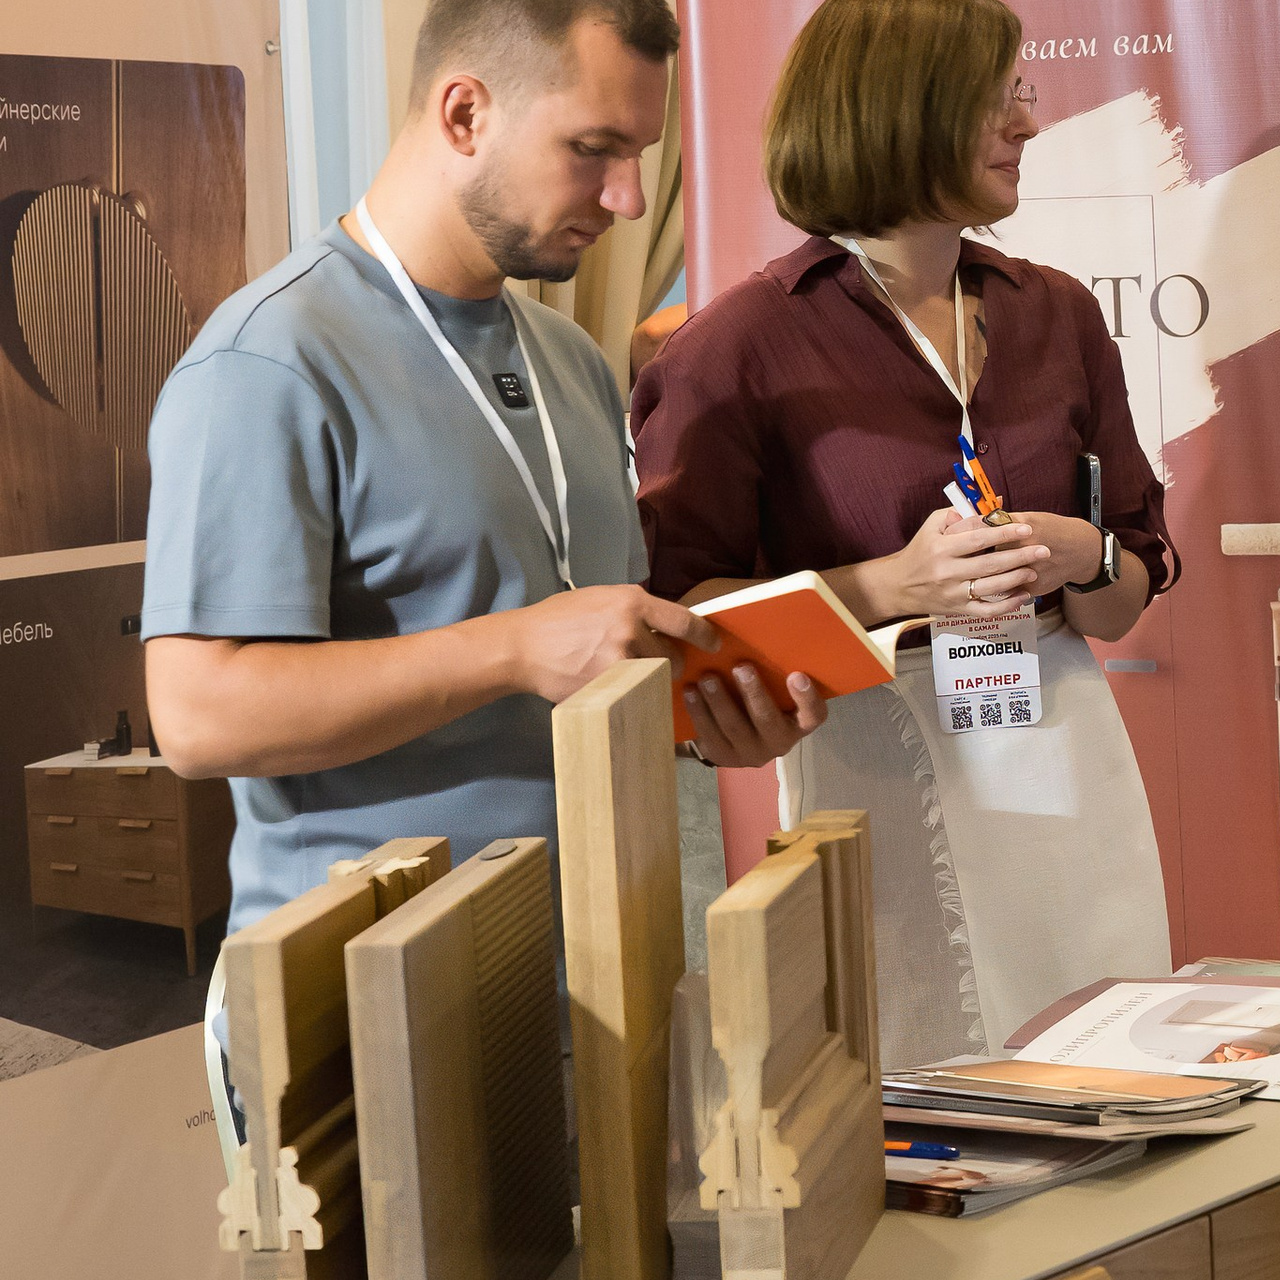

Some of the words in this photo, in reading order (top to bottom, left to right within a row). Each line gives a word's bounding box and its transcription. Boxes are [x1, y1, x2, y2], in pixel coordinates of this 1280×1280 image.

[1021, 37, 1099, 61] ваем
[1113, 33, 1175, 56] вам
[0, 621, 53, 645] ебель
[948, 641, 1023, 659] ВОЛХОВЕЦ
[955, 674, 1021, 690] ПАРТНЕР
